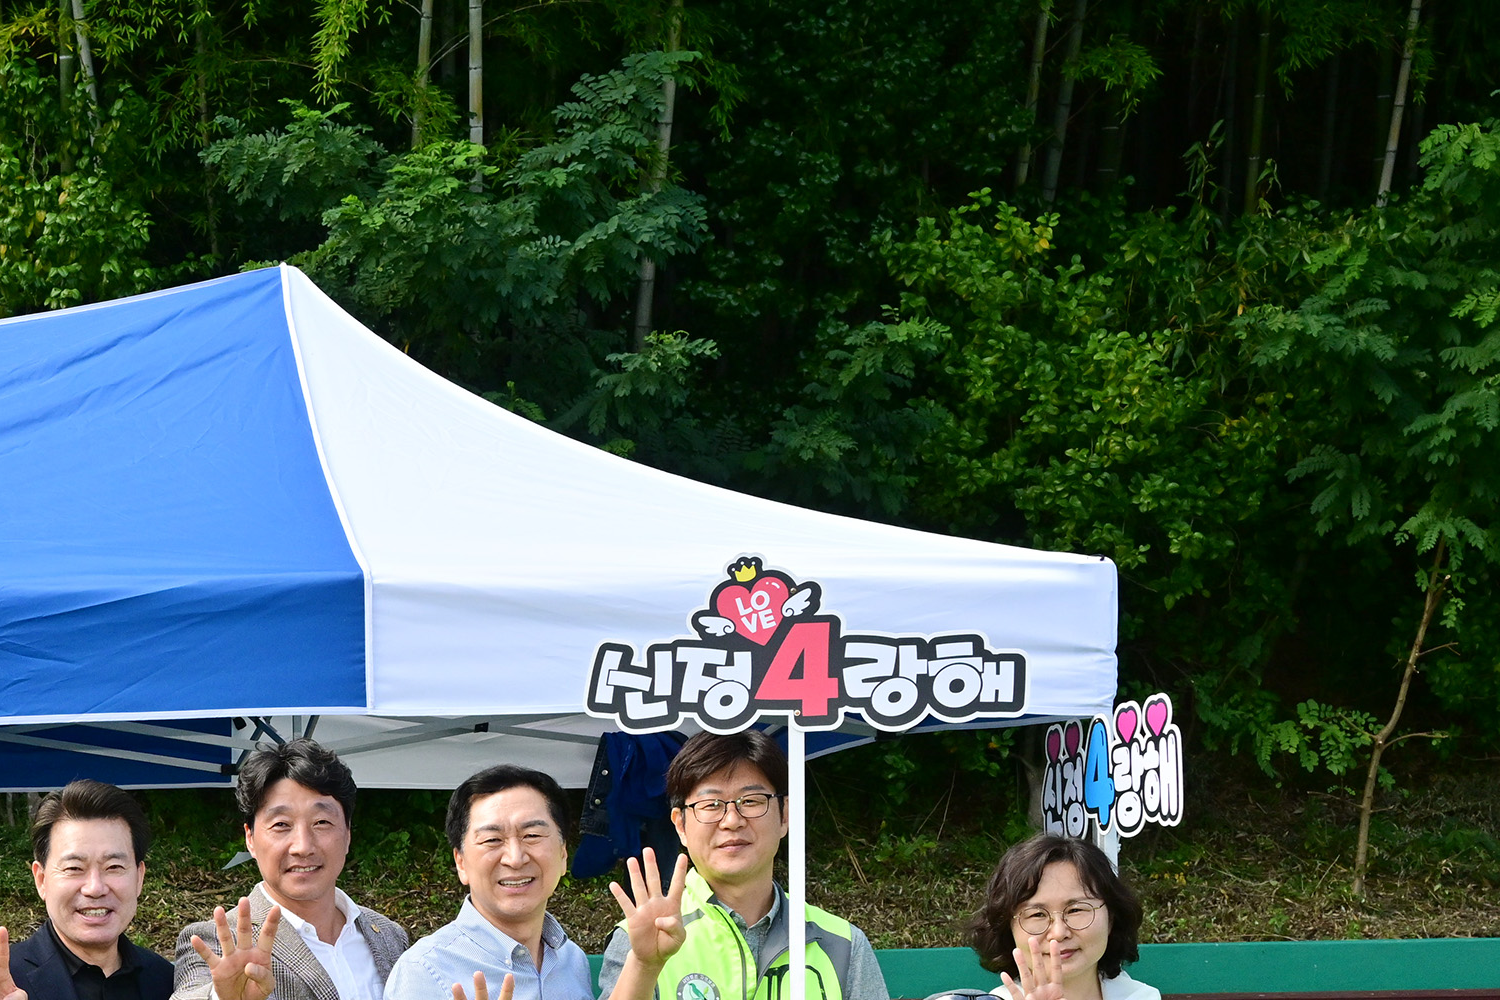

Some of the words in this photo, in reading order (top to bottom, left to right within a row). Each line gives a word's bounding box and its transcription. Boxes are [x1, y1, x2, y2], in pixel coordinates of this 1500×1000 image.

[734, 590, 771, 616] LO
[740, 608, 777, 634] VE
[594, 621, 1015, 721] 신정4랑해
[1043, 721, 1179, 839] 신정4랑해
